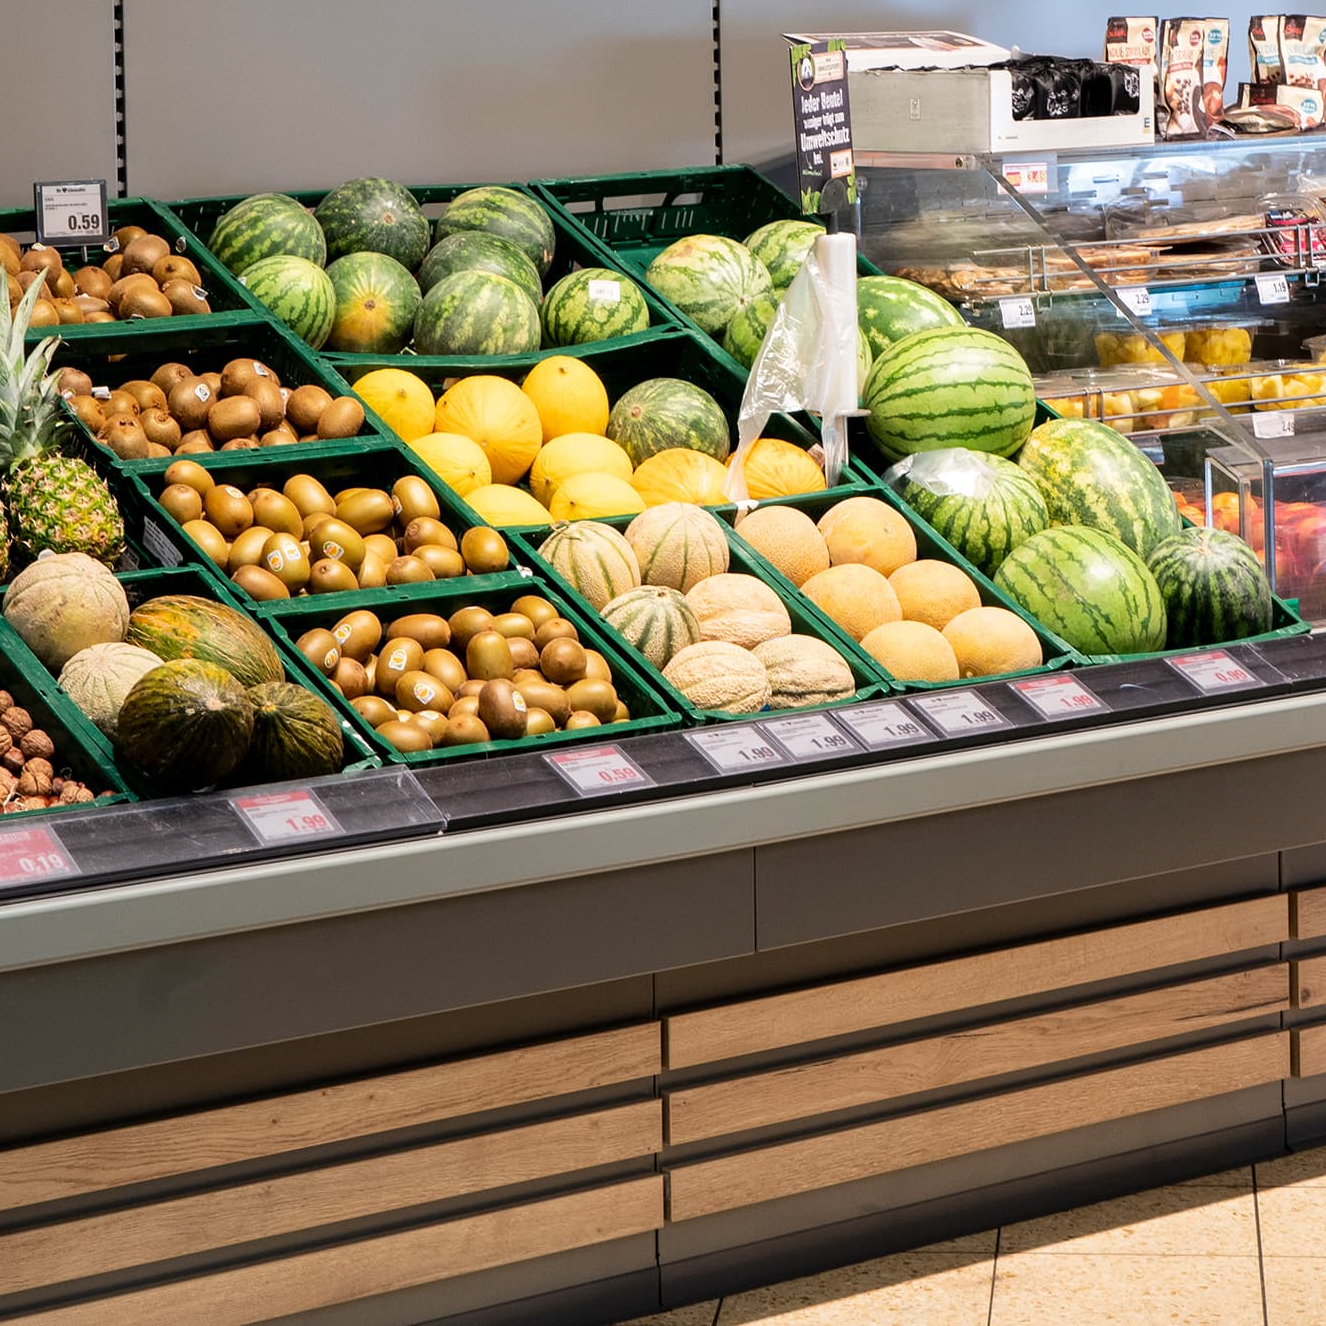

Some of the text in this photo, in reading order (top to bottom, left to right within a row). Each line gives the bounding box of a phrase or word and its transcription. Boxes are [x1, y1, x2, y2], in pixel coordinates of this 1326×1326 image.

[801, 88, 843, 114] Jeder Beutel
[800, 126, 850, 152] Umweltschutz
[68, 214, 100, 230] 0.59
[1216, 669, 1249, 683] 0.99
[1060, 694, 1095, 708] 1.99
[960, 710, 996, 724] 1.99
[883, 723, 920, 737] 1.99
[811, 734, 847, 749] 1.99
[739, 746, 774, 761] 1.99
[598, 767, 637, 783] 0.59
[285, 814, 328, 831] 1.99
[18, 854, 64, 875] 0.19
